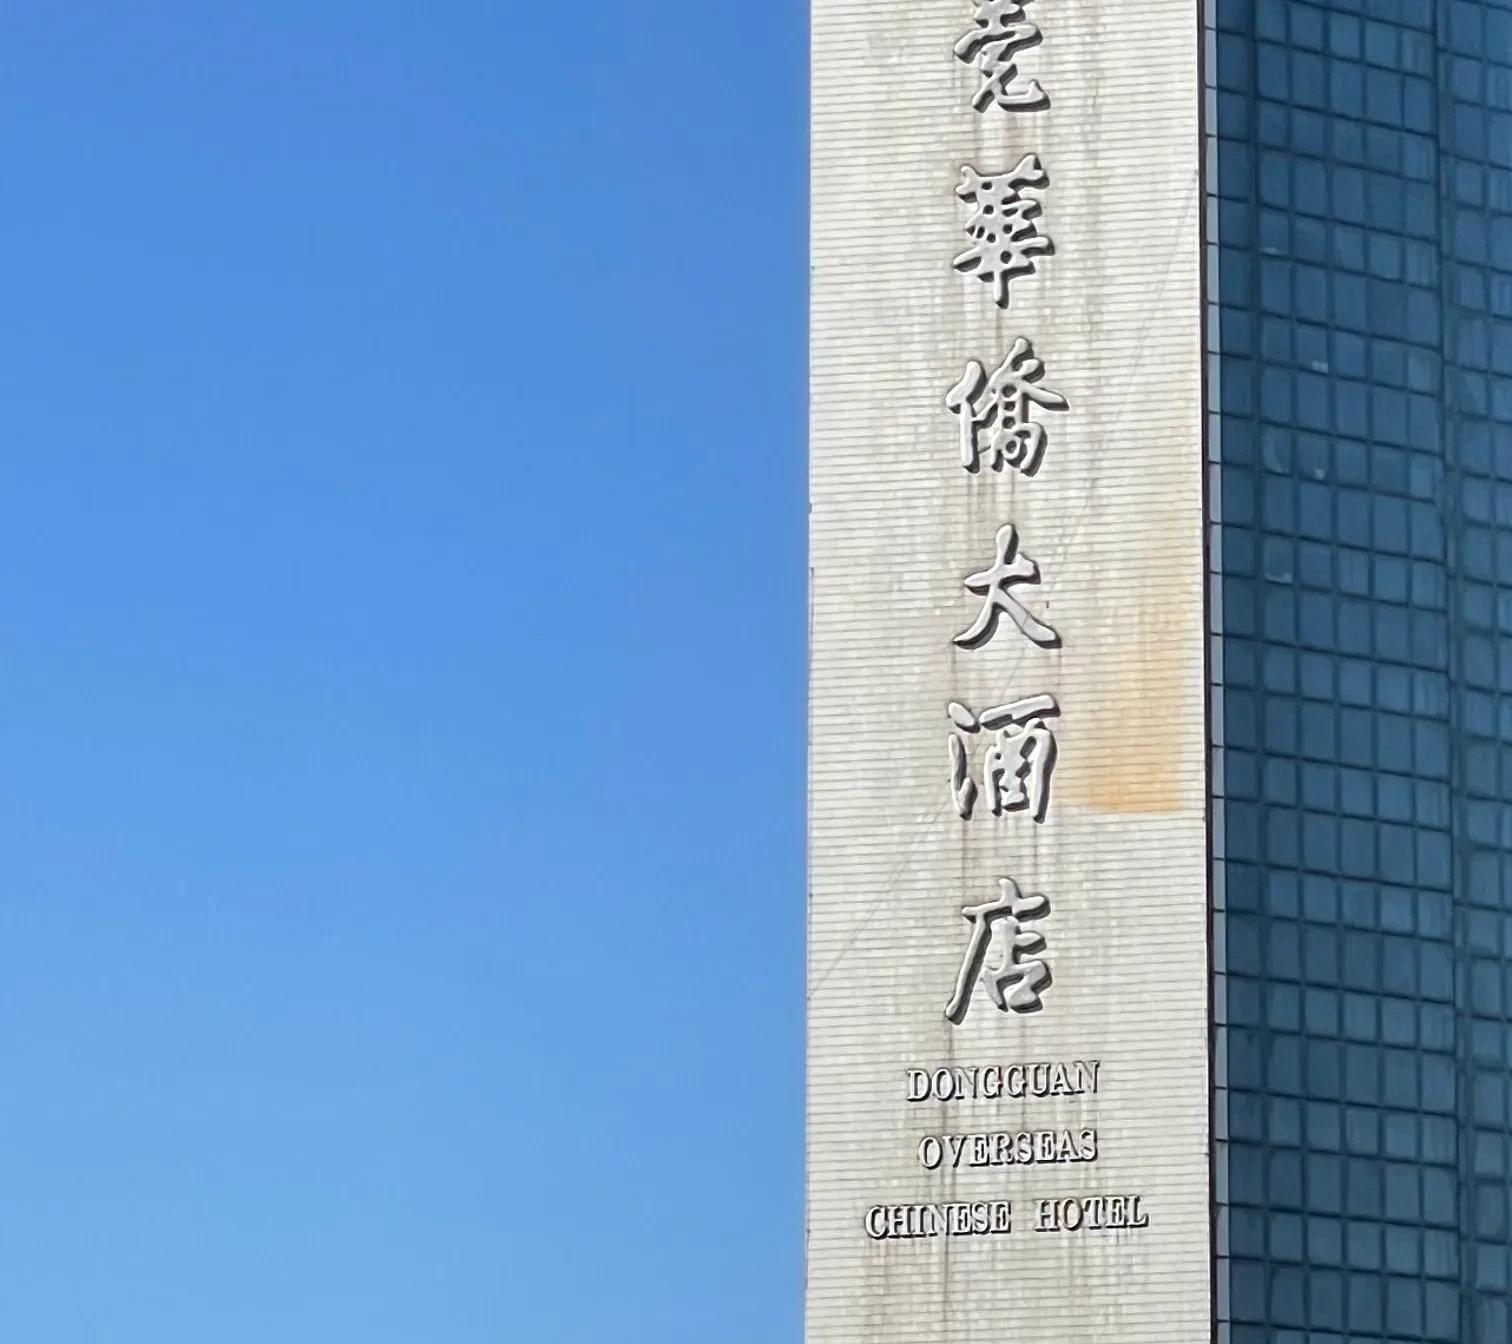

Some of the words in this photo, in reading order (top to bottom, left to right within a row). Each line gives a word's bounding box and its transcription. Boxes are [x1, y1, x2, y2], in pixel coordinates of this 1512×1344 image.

[906, 1060, 1099, 1102] DONGGUAN
[918, 1128, 1098, 1170] OVERSEAS
[865, 1200, 1012, 1240] CHINESE
[1034, 1194, 1149, 1233] HOTEL
